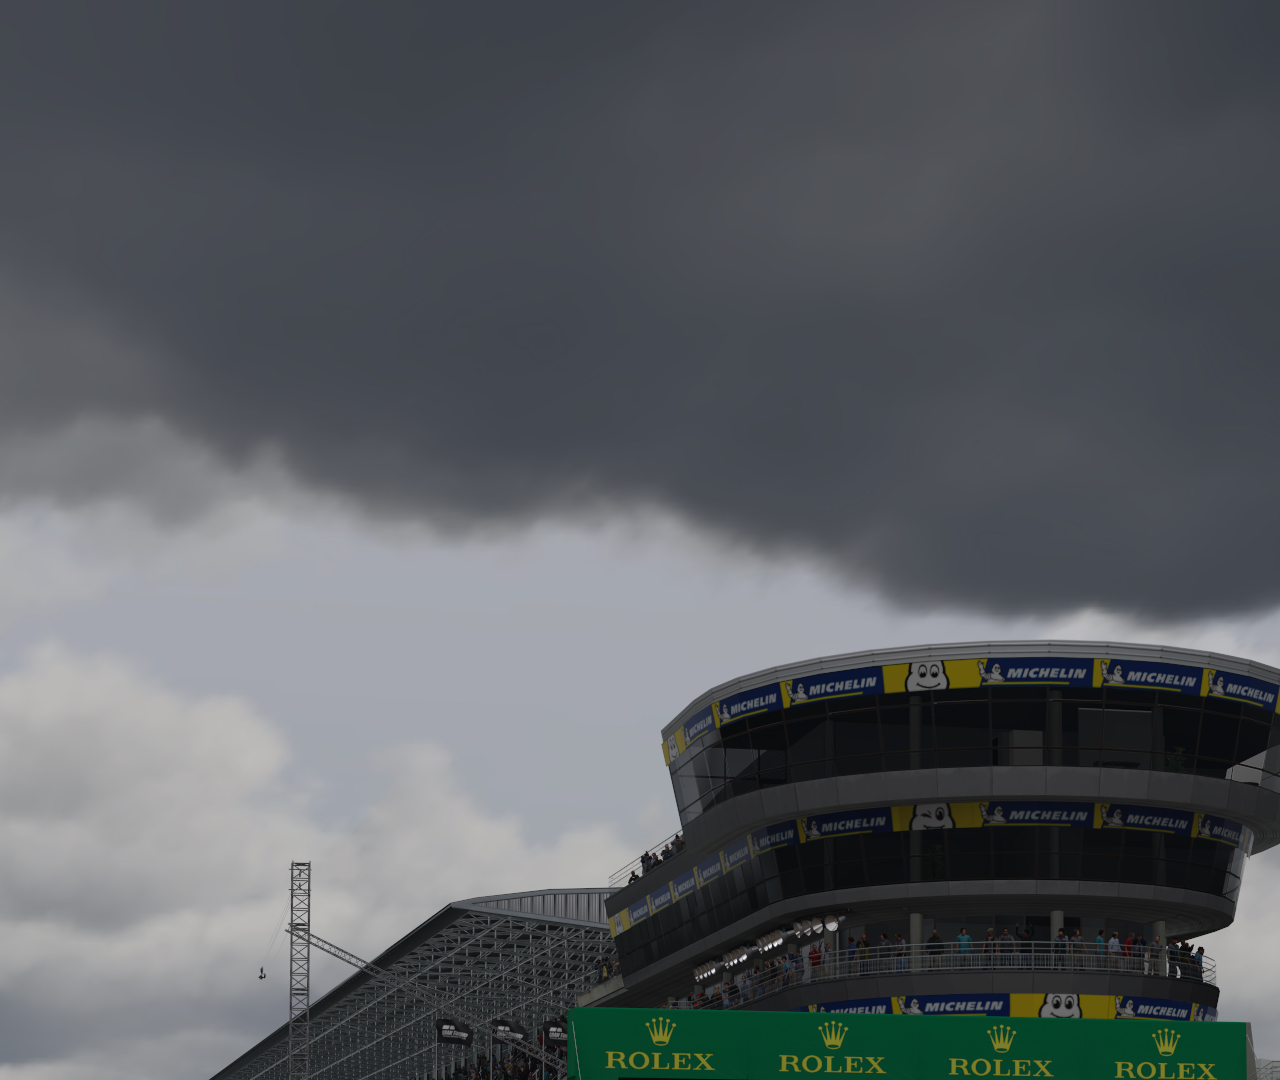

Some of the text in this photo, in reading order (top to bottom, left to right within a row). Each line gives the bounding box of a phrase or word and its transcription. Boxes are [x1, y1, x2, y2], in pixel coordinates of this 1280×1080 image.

[1007, 668, 1087, 679] MICHELIN
[1126, 671, 1197, 688] MICHELIN
[808, 677, 877, 696] MICHELIN
[1226, 683, 1275, 704] MICHELIN
[730, 693, 777, 715] MICHELIN
[689, 715, 713, 738] MICHELIN
[821, 816, 886, 833] MICHELIN
[1008, 810, 1088, 822] MICHELIN
[1126, 814, 1189, 830] MICHELIN
[759, 829, 794, 848] MICHELIN
[729, 846, 749, 863] MICHELIN
[924, 1001, 1004, 1012] MICHELIN
[1137, 1004, 1188, 1019] MICHELIN
[604, 1051, 716, 1071] ROLEX
[779, 1054, 887, 1075] ROLEX
[948, 1057, 1055, 1078] ROLEX
[1113, 1060, 1218, 1080] ROLEX
